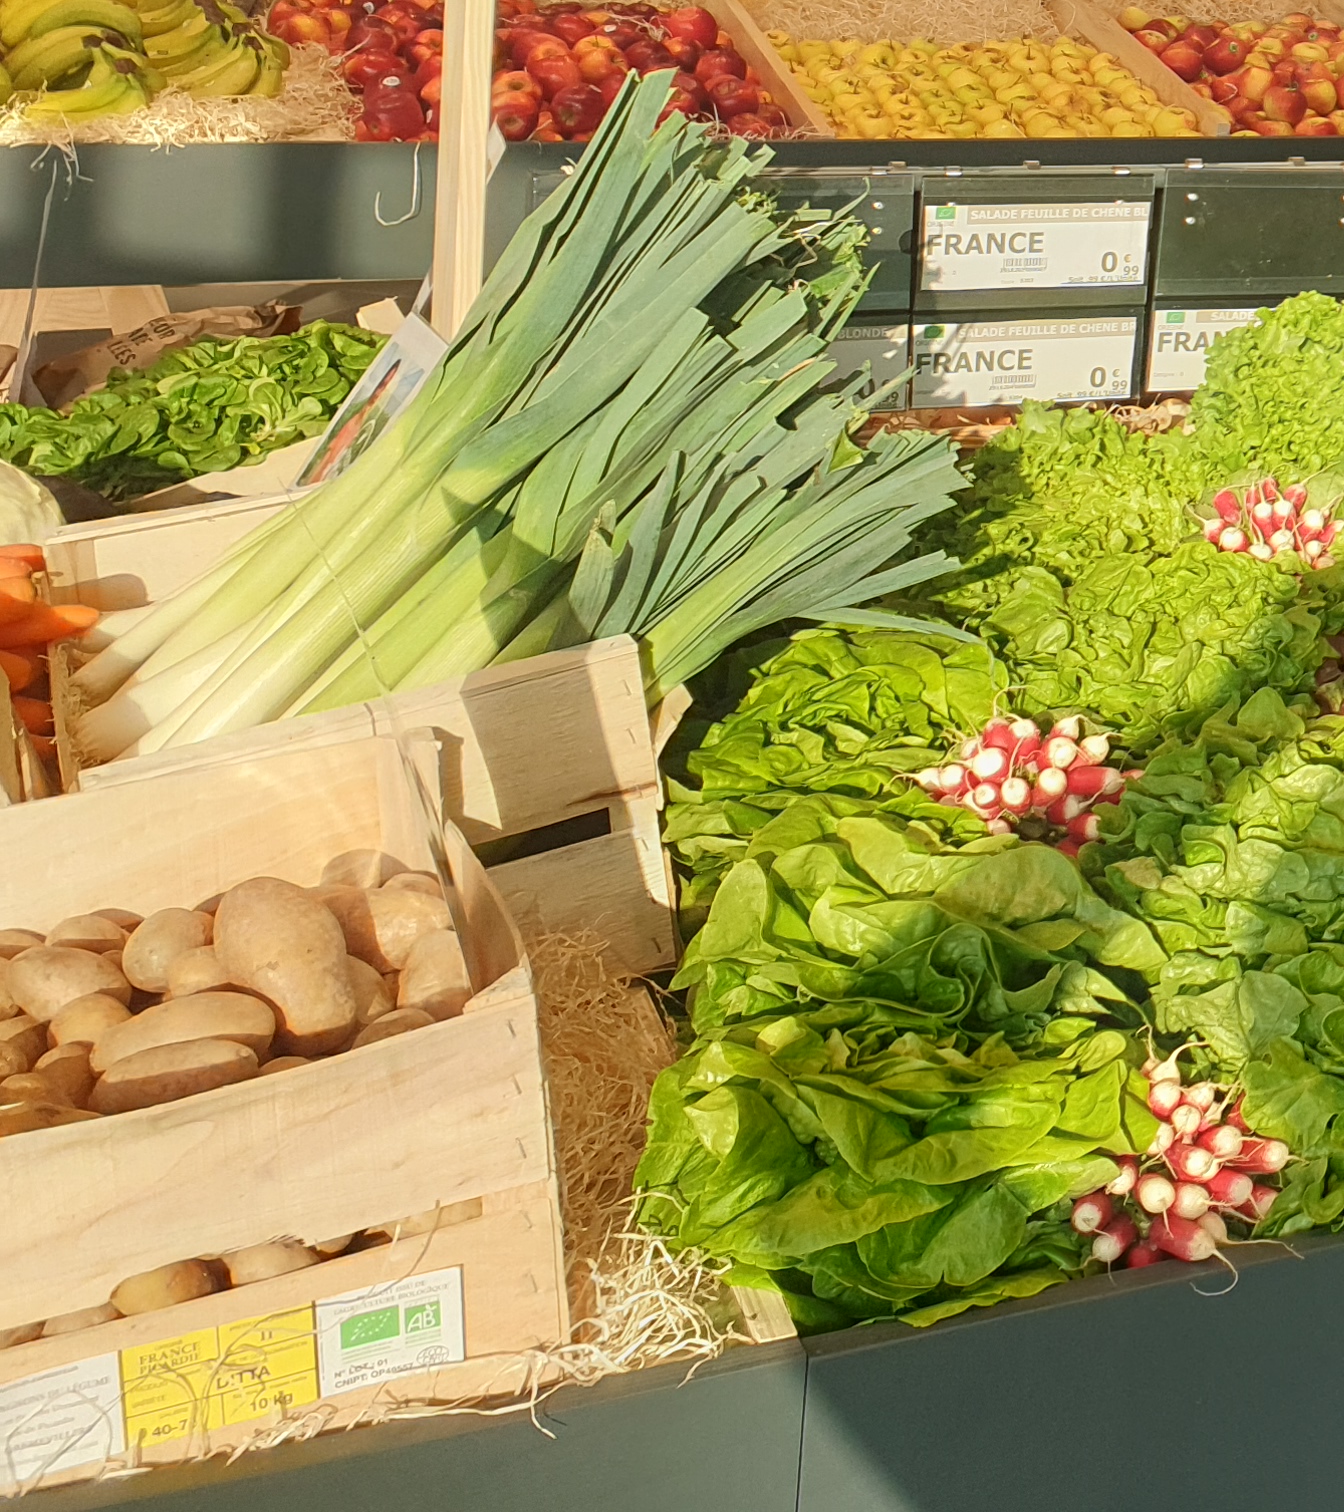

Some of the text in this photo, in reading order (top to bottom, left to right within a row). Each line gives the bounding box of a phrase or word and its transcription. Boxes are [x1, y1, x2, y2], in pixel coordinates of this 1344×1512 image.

[970, 209, 1018, 221] SALADE
[1020, 208, 1071, 220] FEUILLE
[1073, 207, 1088, 218] DE
[926, 231, 1045, 256] FRANCE
[1101, 251, 1118, 273] 0
[1123, 265, 1140, 276] 99
[1210, 311, 1254, 321] SALADE
[958, 326, 1006, 338] SALADE
[1008, 324, 1060, 337] FEUILLE
[1062, 324, 1078, 334] DE
[1157, 331, 1228, 353] FRA
[915, 348, 1034, 375] FRANCE
[1090, 366, 1107, 388] 0
[1112, 380, 1128, 391] 99
[407, 1306, 438, 1333] AB
[250, 1398, 268, 1412] 10
[151, 1418, 190, 1437] 40-7
